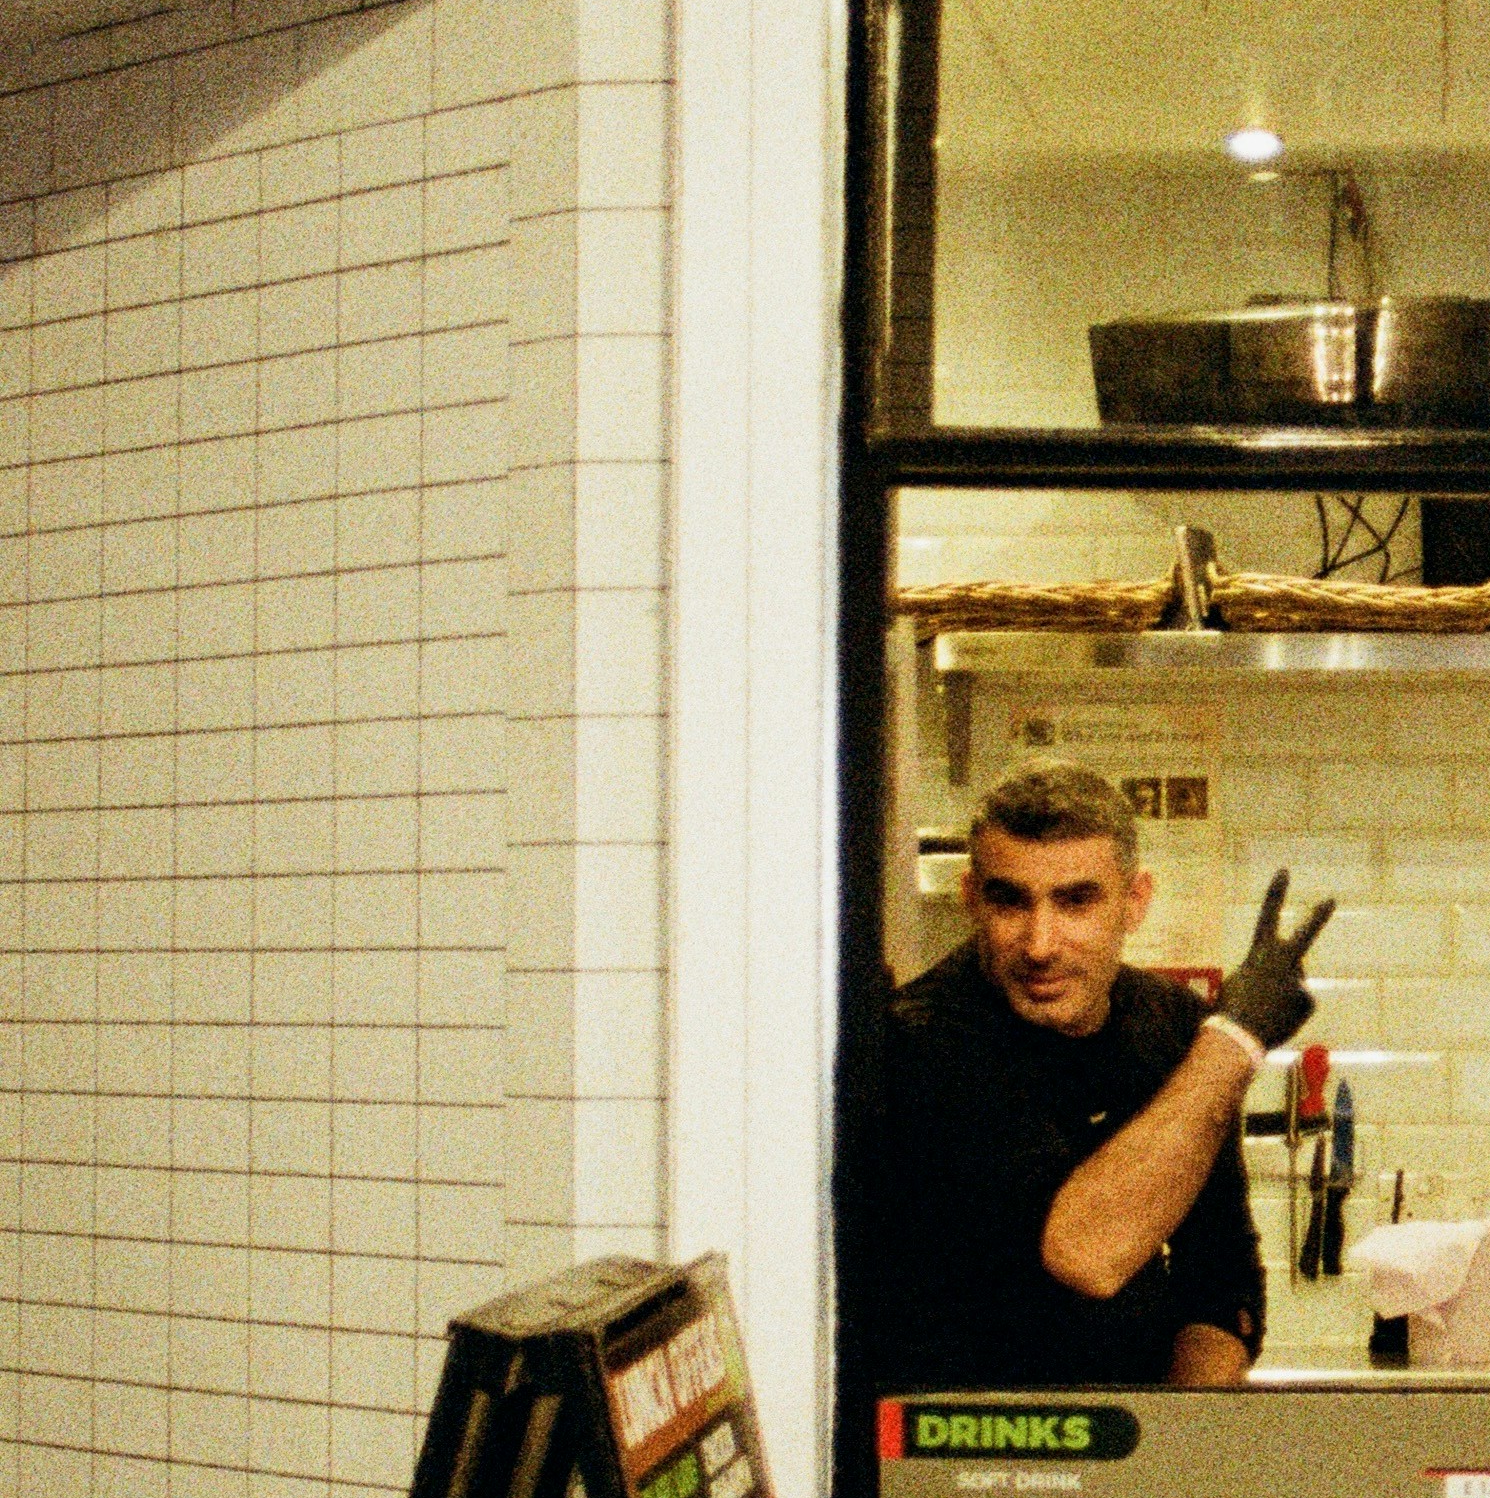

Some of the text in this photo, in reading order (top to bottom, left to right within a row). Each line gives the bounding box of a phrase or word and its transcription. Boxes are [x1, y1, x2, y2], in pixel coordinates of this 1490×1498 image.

[917, 1415, 1091, 1450] DRINKS
[956, 1472, 1082, 1490] SOFT DRINK
